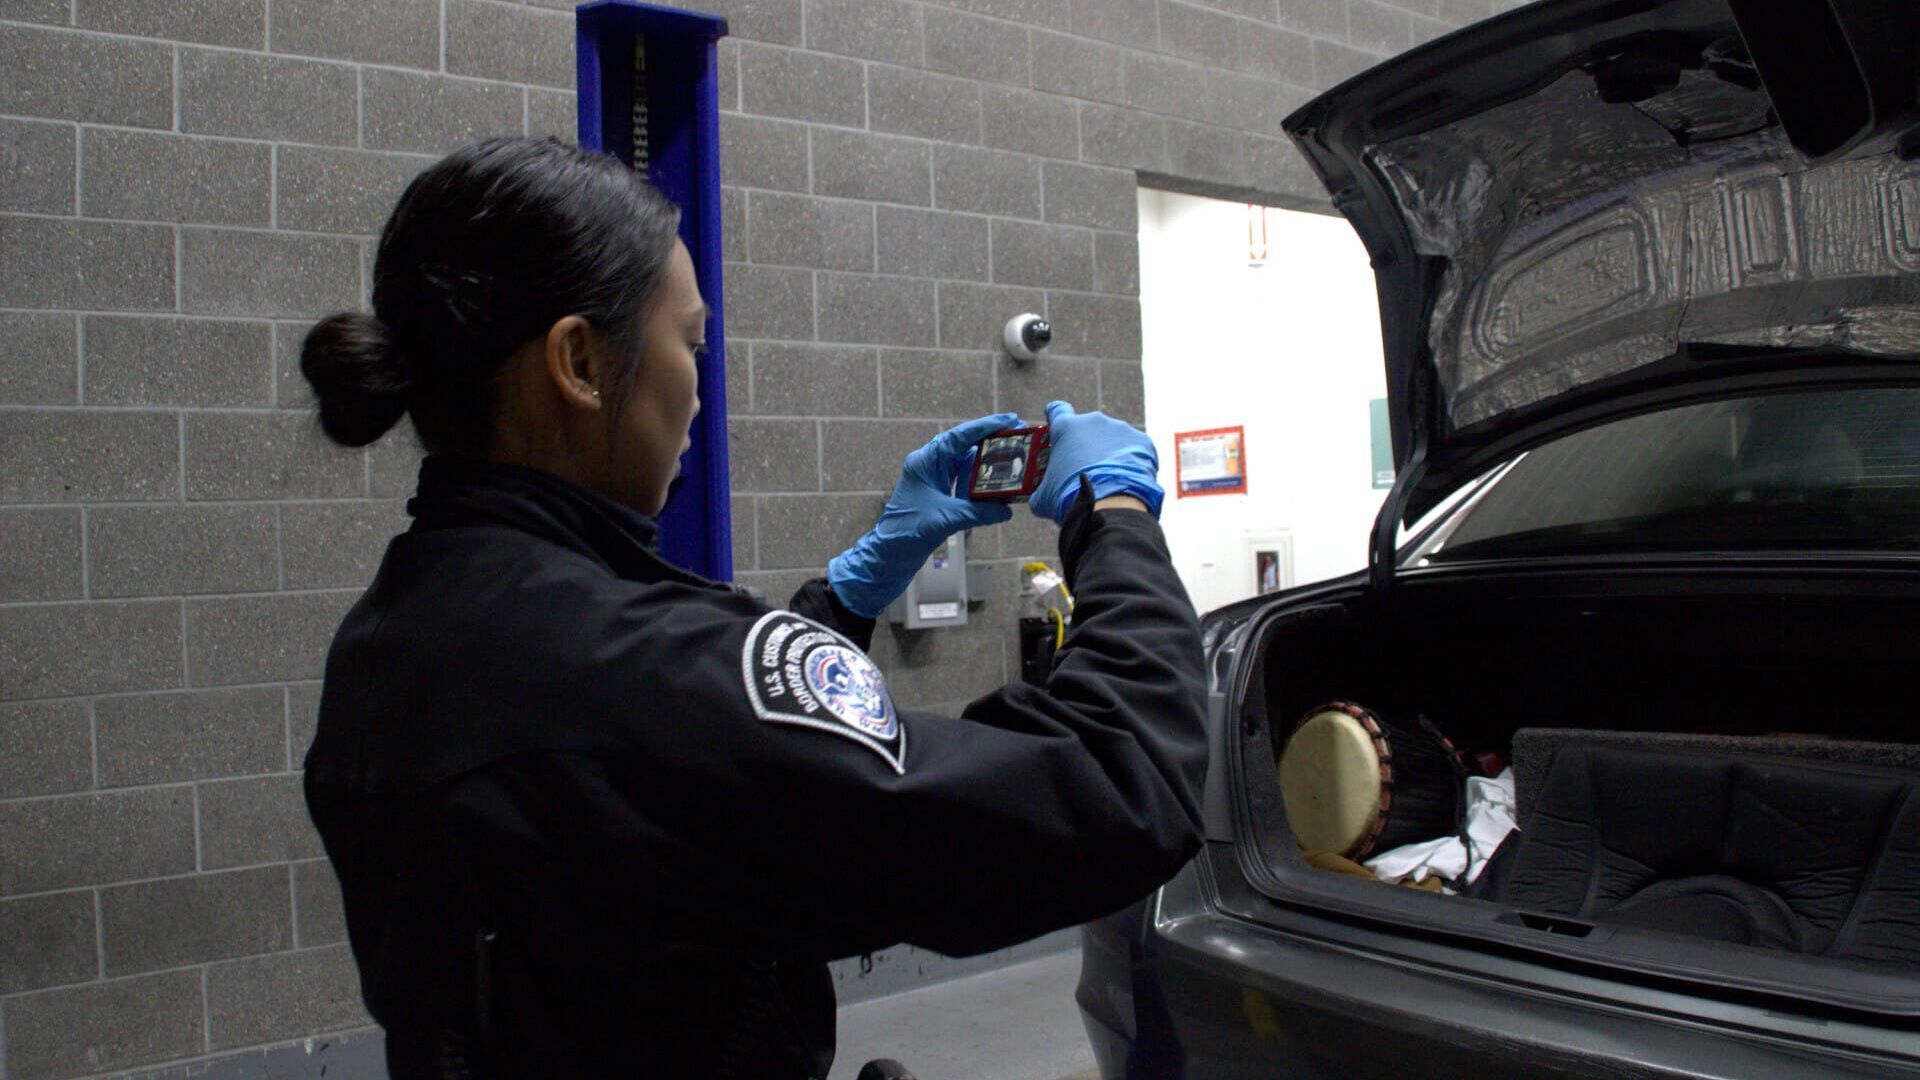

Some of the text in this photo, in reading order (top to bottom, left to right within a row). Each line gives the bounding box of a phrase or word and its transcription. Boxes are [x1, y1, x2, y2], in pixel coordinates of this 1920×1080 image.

[786, 631, 838, 664] PROTEC
[764, 671, 785, 697] U.S.
[784, 663, 819, 713] BORDER
